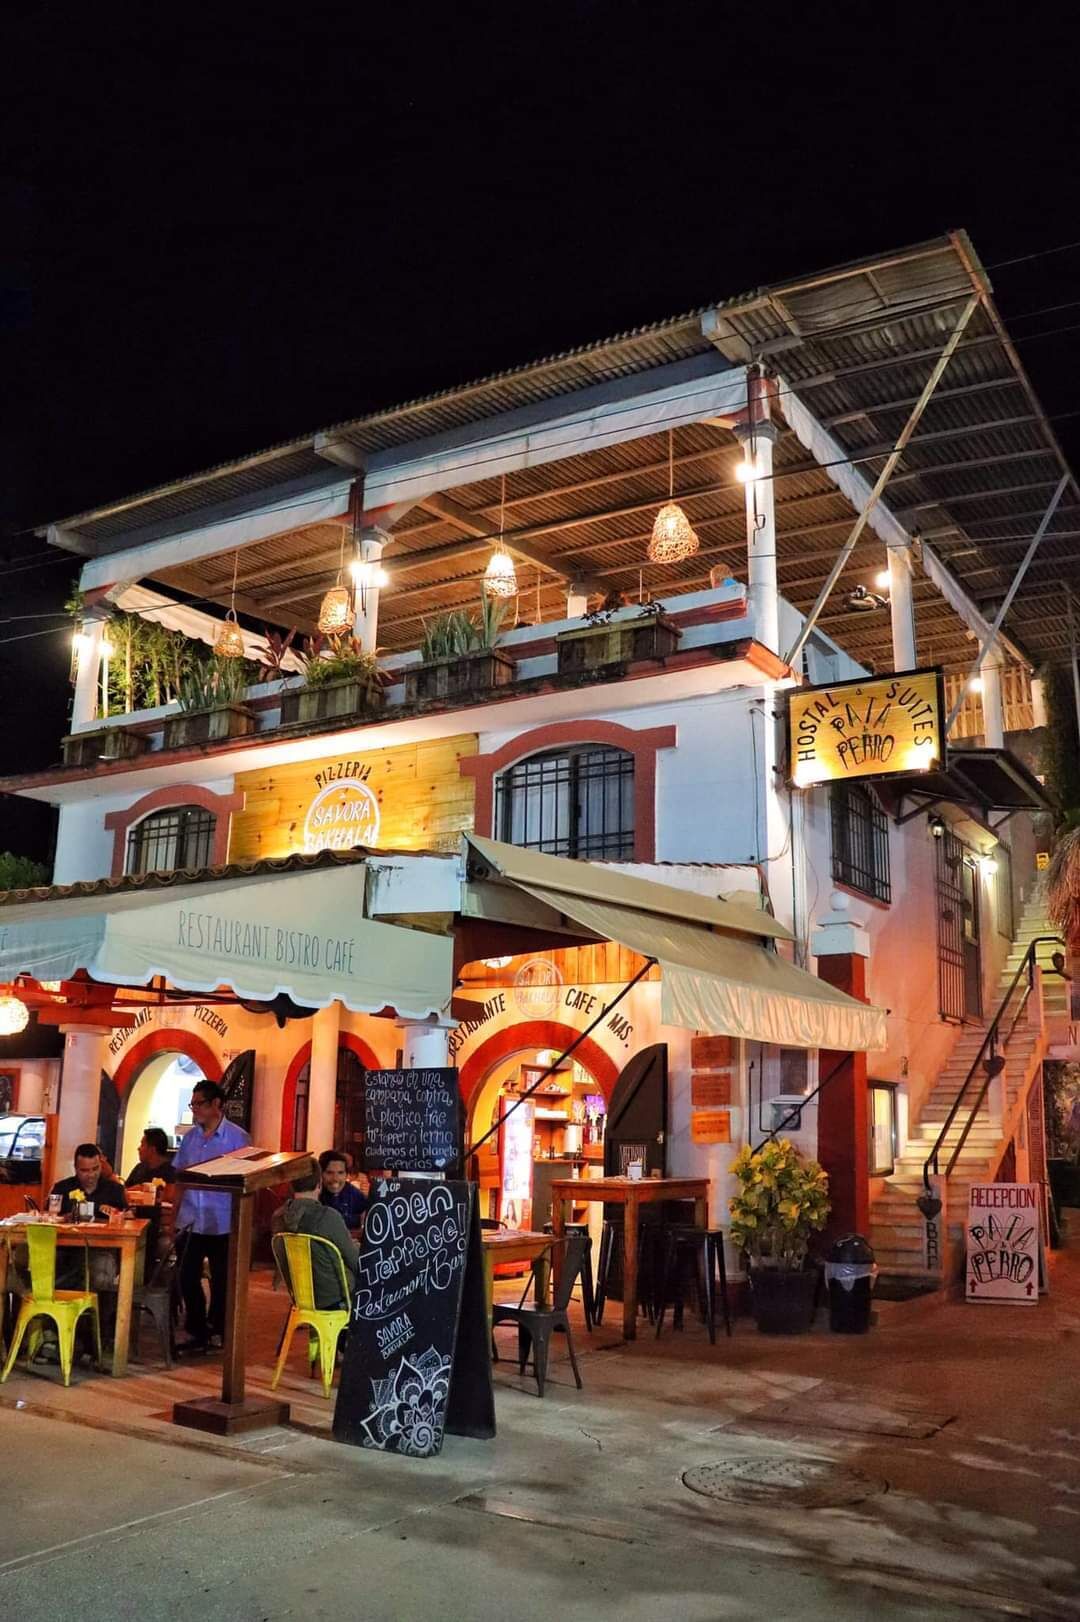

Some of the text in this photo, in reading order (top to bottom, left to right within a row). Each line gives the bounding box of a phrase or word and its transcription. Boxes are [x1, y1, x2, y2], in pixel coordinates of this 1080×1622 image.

[797, 692, 840, 762] HOSTAL
[886, 682, 934, 746] SUITES
[836, 734, 895, 770] PERRO
[314, 761, 372, 789] PIZZERIA
[312, 799, 371, 828] SAVORA
[178, 910, 355, 975] RESTAURANT BISTRO CAFÉ
[565, 988, 597, 1015] CAFE
[194, 1005, 228, 1038] PIZZERIA
[971, 1188, 1035, 1209] RECEPCION
[376, 1311, 412, 1348] SAVORA
